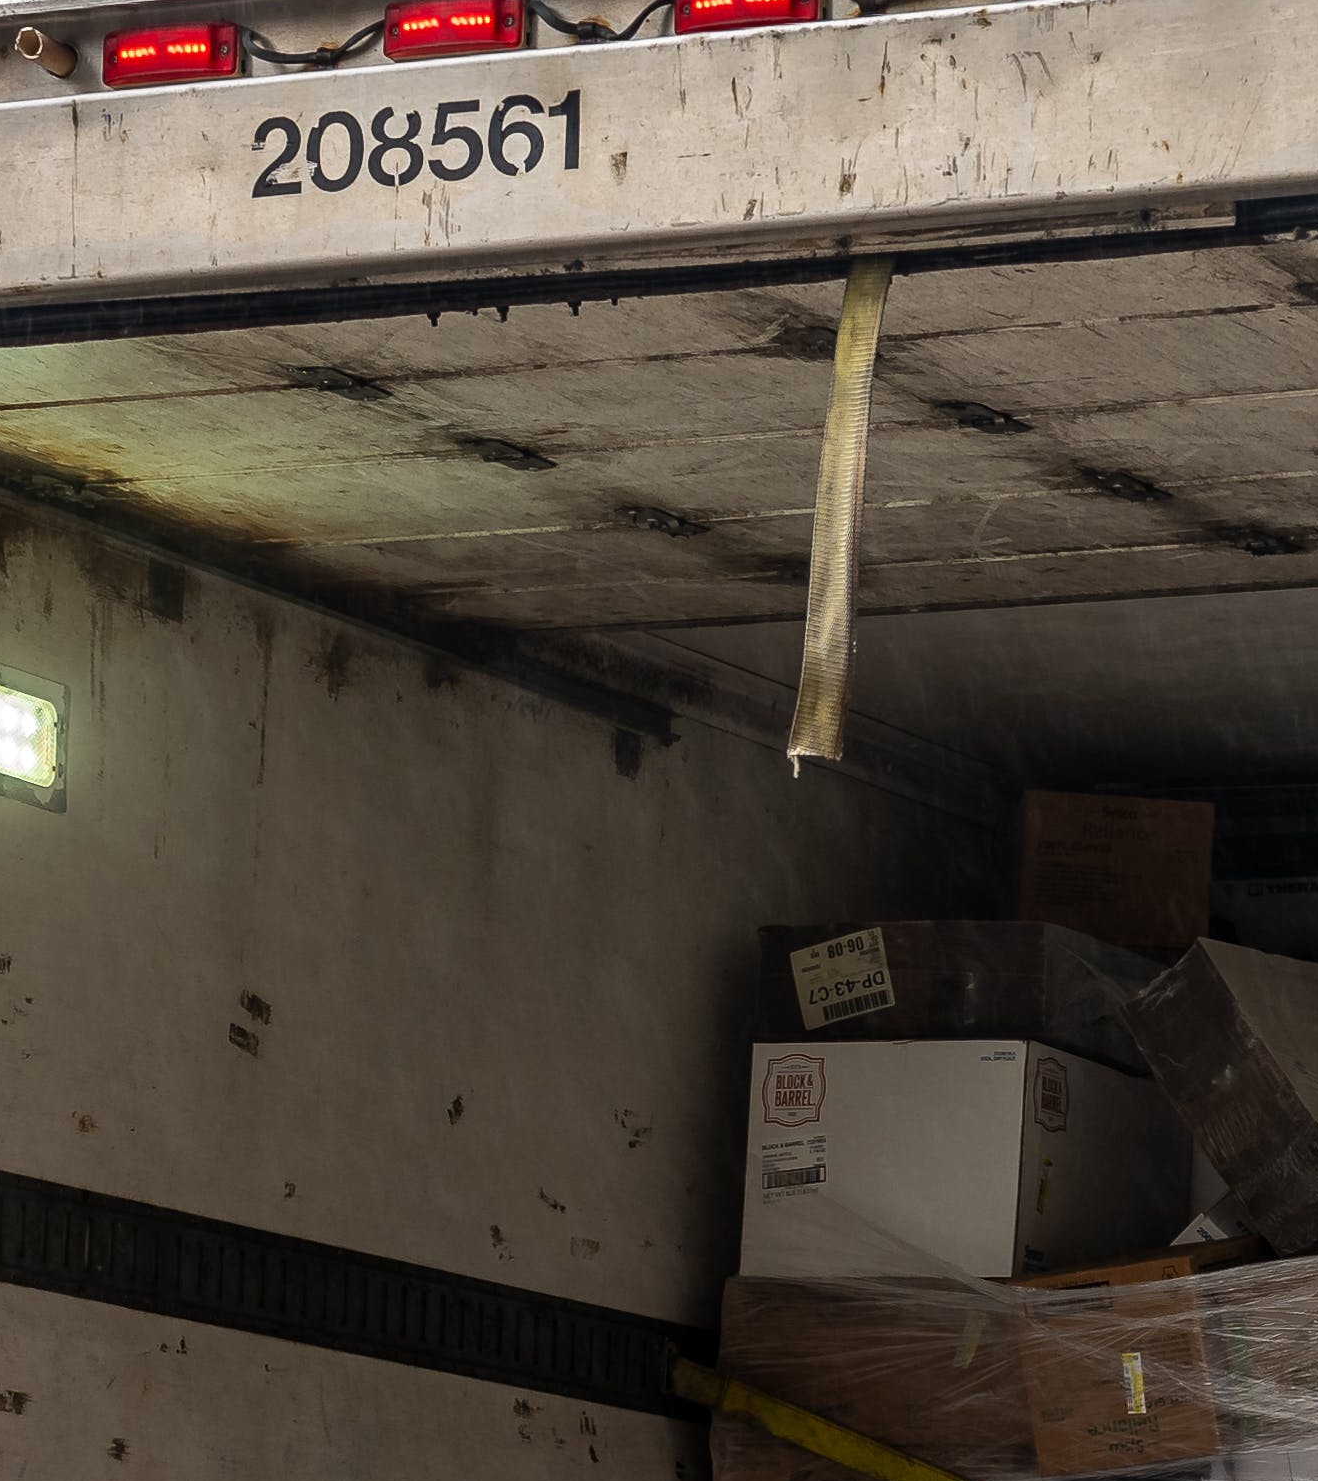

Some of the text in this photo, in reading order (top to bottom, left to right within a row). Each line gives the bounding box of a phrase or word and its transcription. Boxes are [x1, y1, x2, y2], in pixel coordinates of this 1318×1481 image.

[251, 89, 581, 199] 208561
[809, 970, 885, 1004] DP-43-C7
[775, 1074, 806, 1090] BLOCK
[774, 1090, 812, 1107] BARREL
